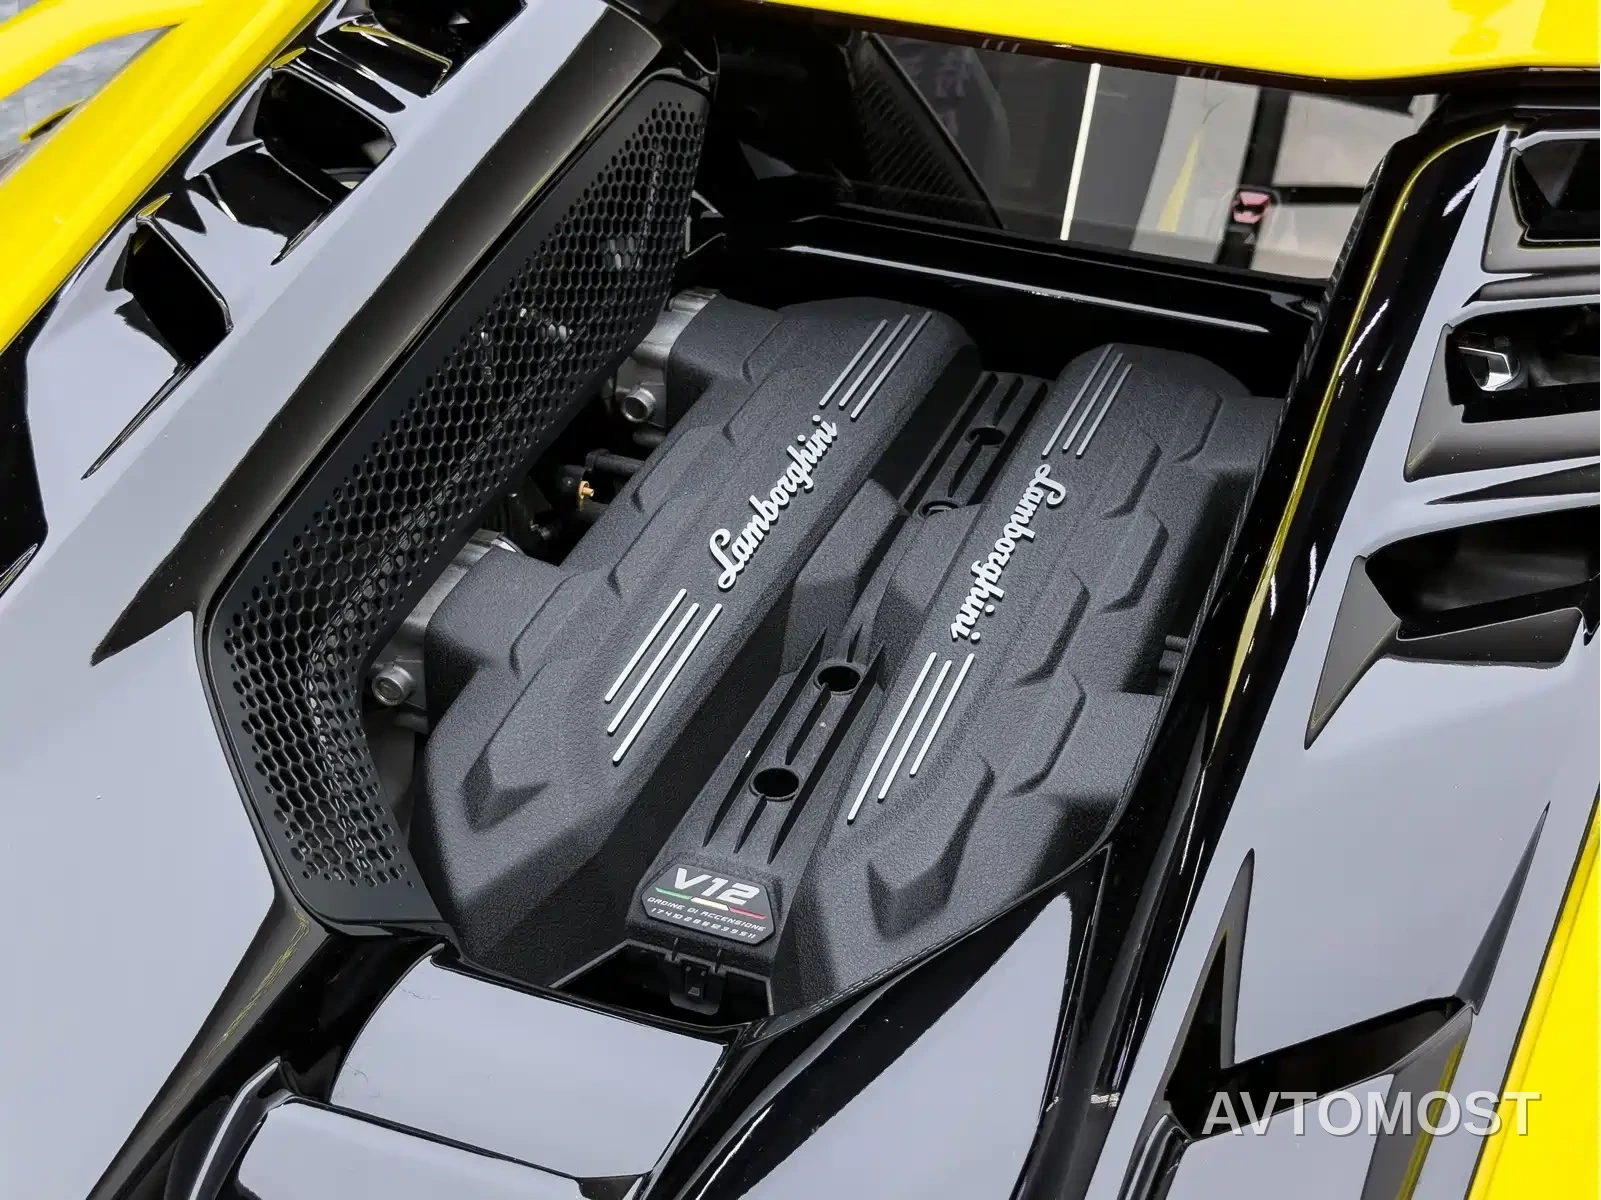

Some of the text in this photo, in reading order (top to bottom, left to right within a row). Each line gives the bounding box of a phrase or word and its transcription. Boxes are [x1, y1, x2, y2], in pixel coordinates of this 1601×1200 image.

[709, 414, 838, 589] Lamborghini
[950, 463, 1067, 641] Lamborghini
[646, 896, 686, 911] ORDINE
[700, 910, 767, 932] ACCENSIONE
[674, 867, 760, 906] V12
